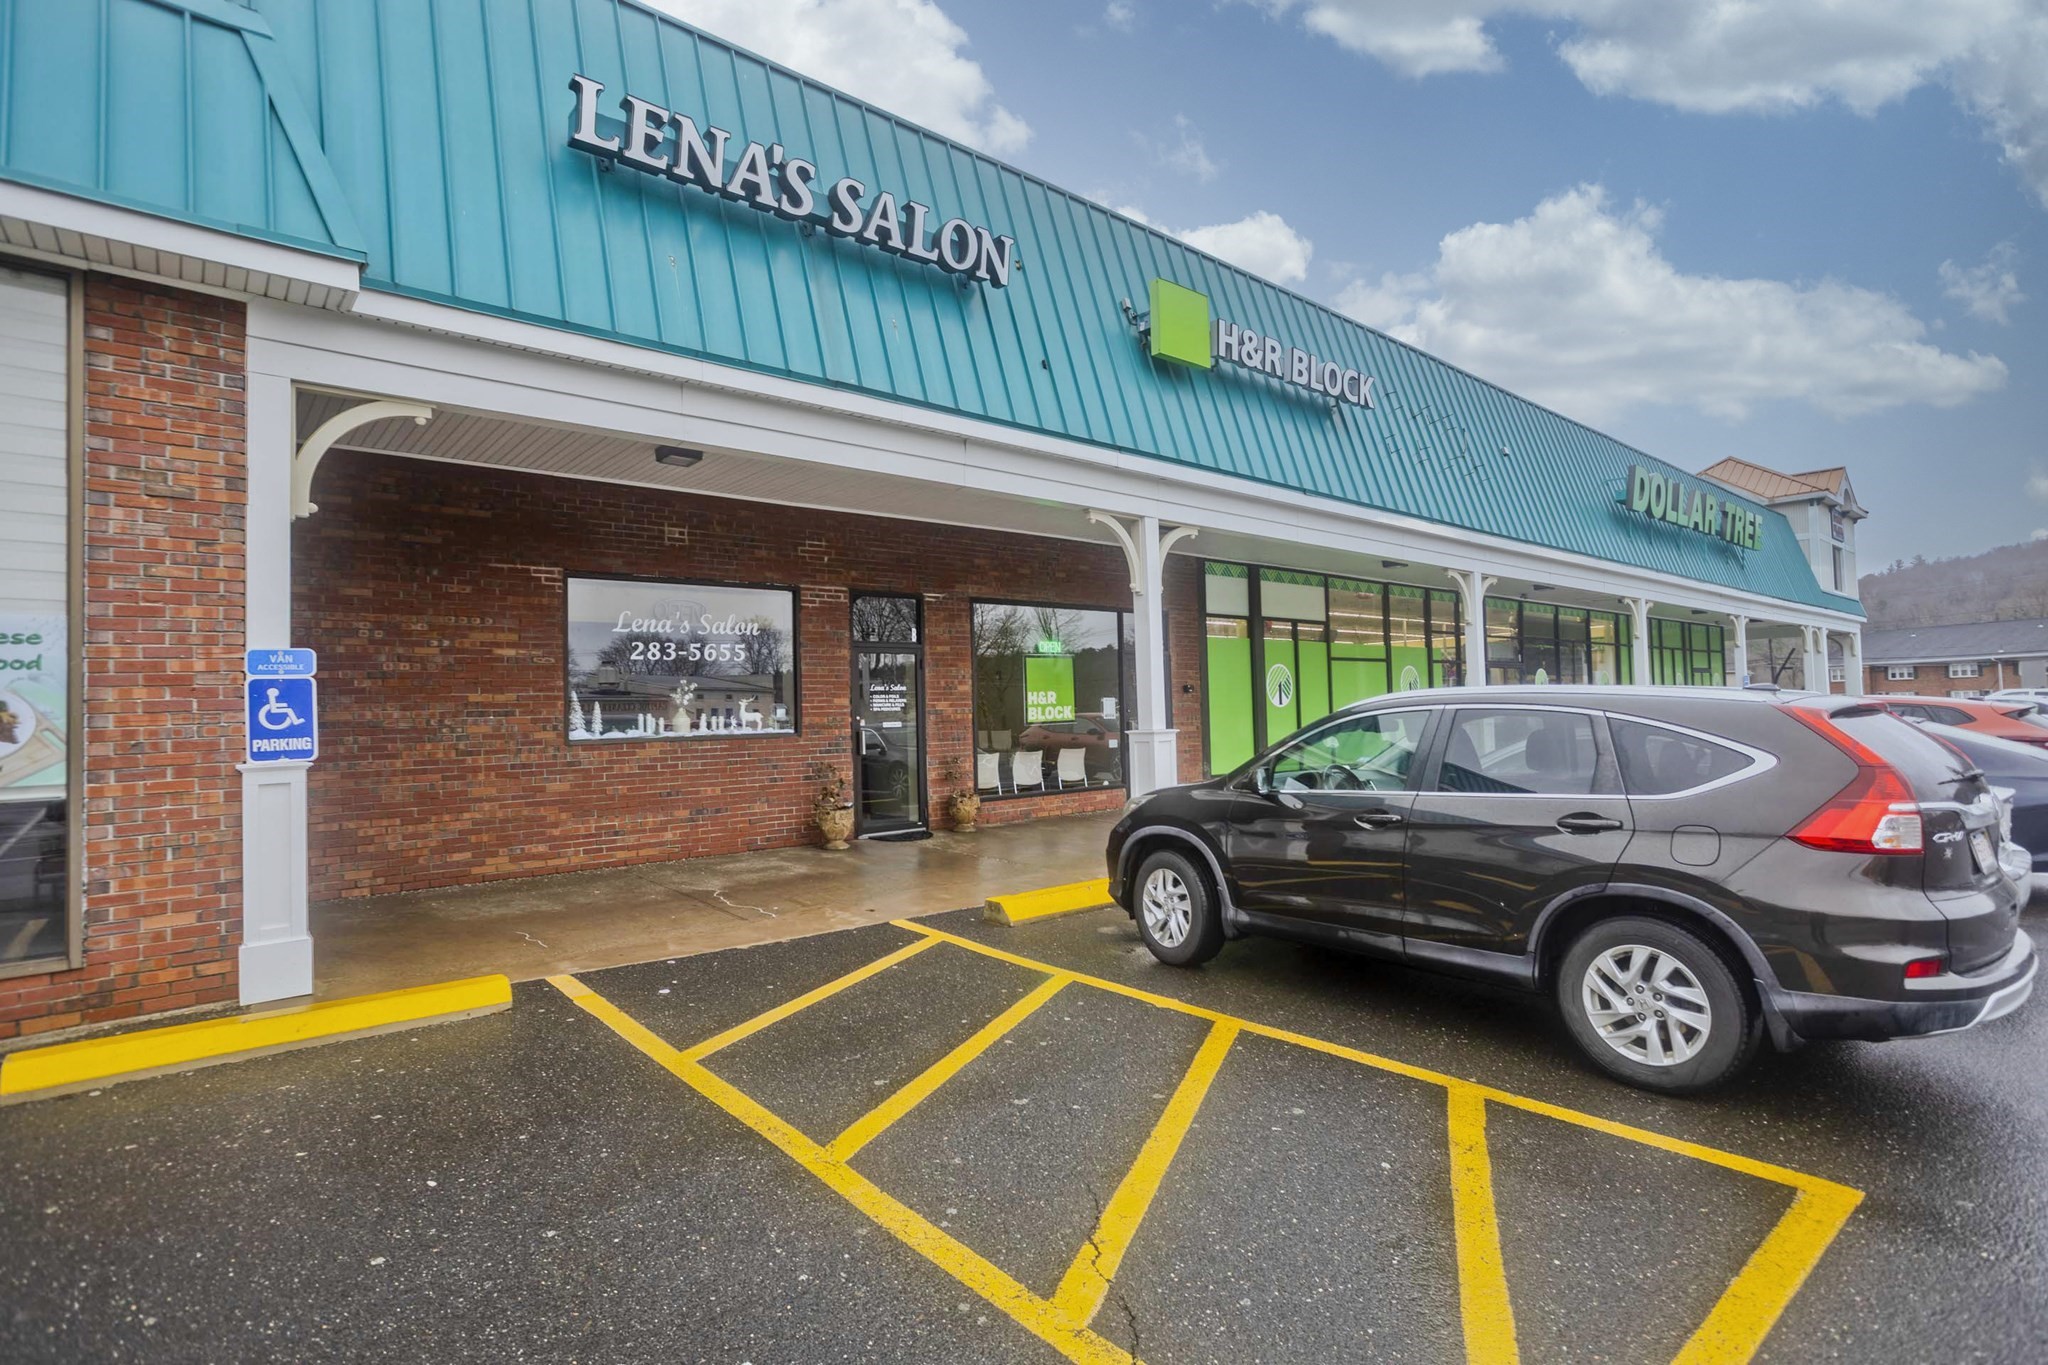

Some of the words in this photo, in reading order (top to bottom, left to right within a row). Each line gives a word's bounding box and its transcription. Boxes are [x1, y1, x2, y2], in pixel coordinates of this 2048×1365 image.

[571, 74, 816, 216] LENA'S
[830, 177, 1014, 287] SALON
[1214, 318, 1283, 378] H&R
[1289, 347, 1375, 409] BLOCK
[1630, 464, 1716, 536] DOLLAR
[1722, 501, 1763, 551] TREE
[612, 610, 690, 634] Lena's
[697, 614, 761, 636] Salon
[630, 641, 746, 661] 283-5655
[1038, 641, 1062, 653] OPEN
[257, 663, 305, 671] ACCESSIBLE
[269, 654, 294, 664] VAN
[1027, 691, 1057, 705] H&R
[1027, 706, 1073, 721] BLOCK
[252, 737, 313, 753] PARKING
